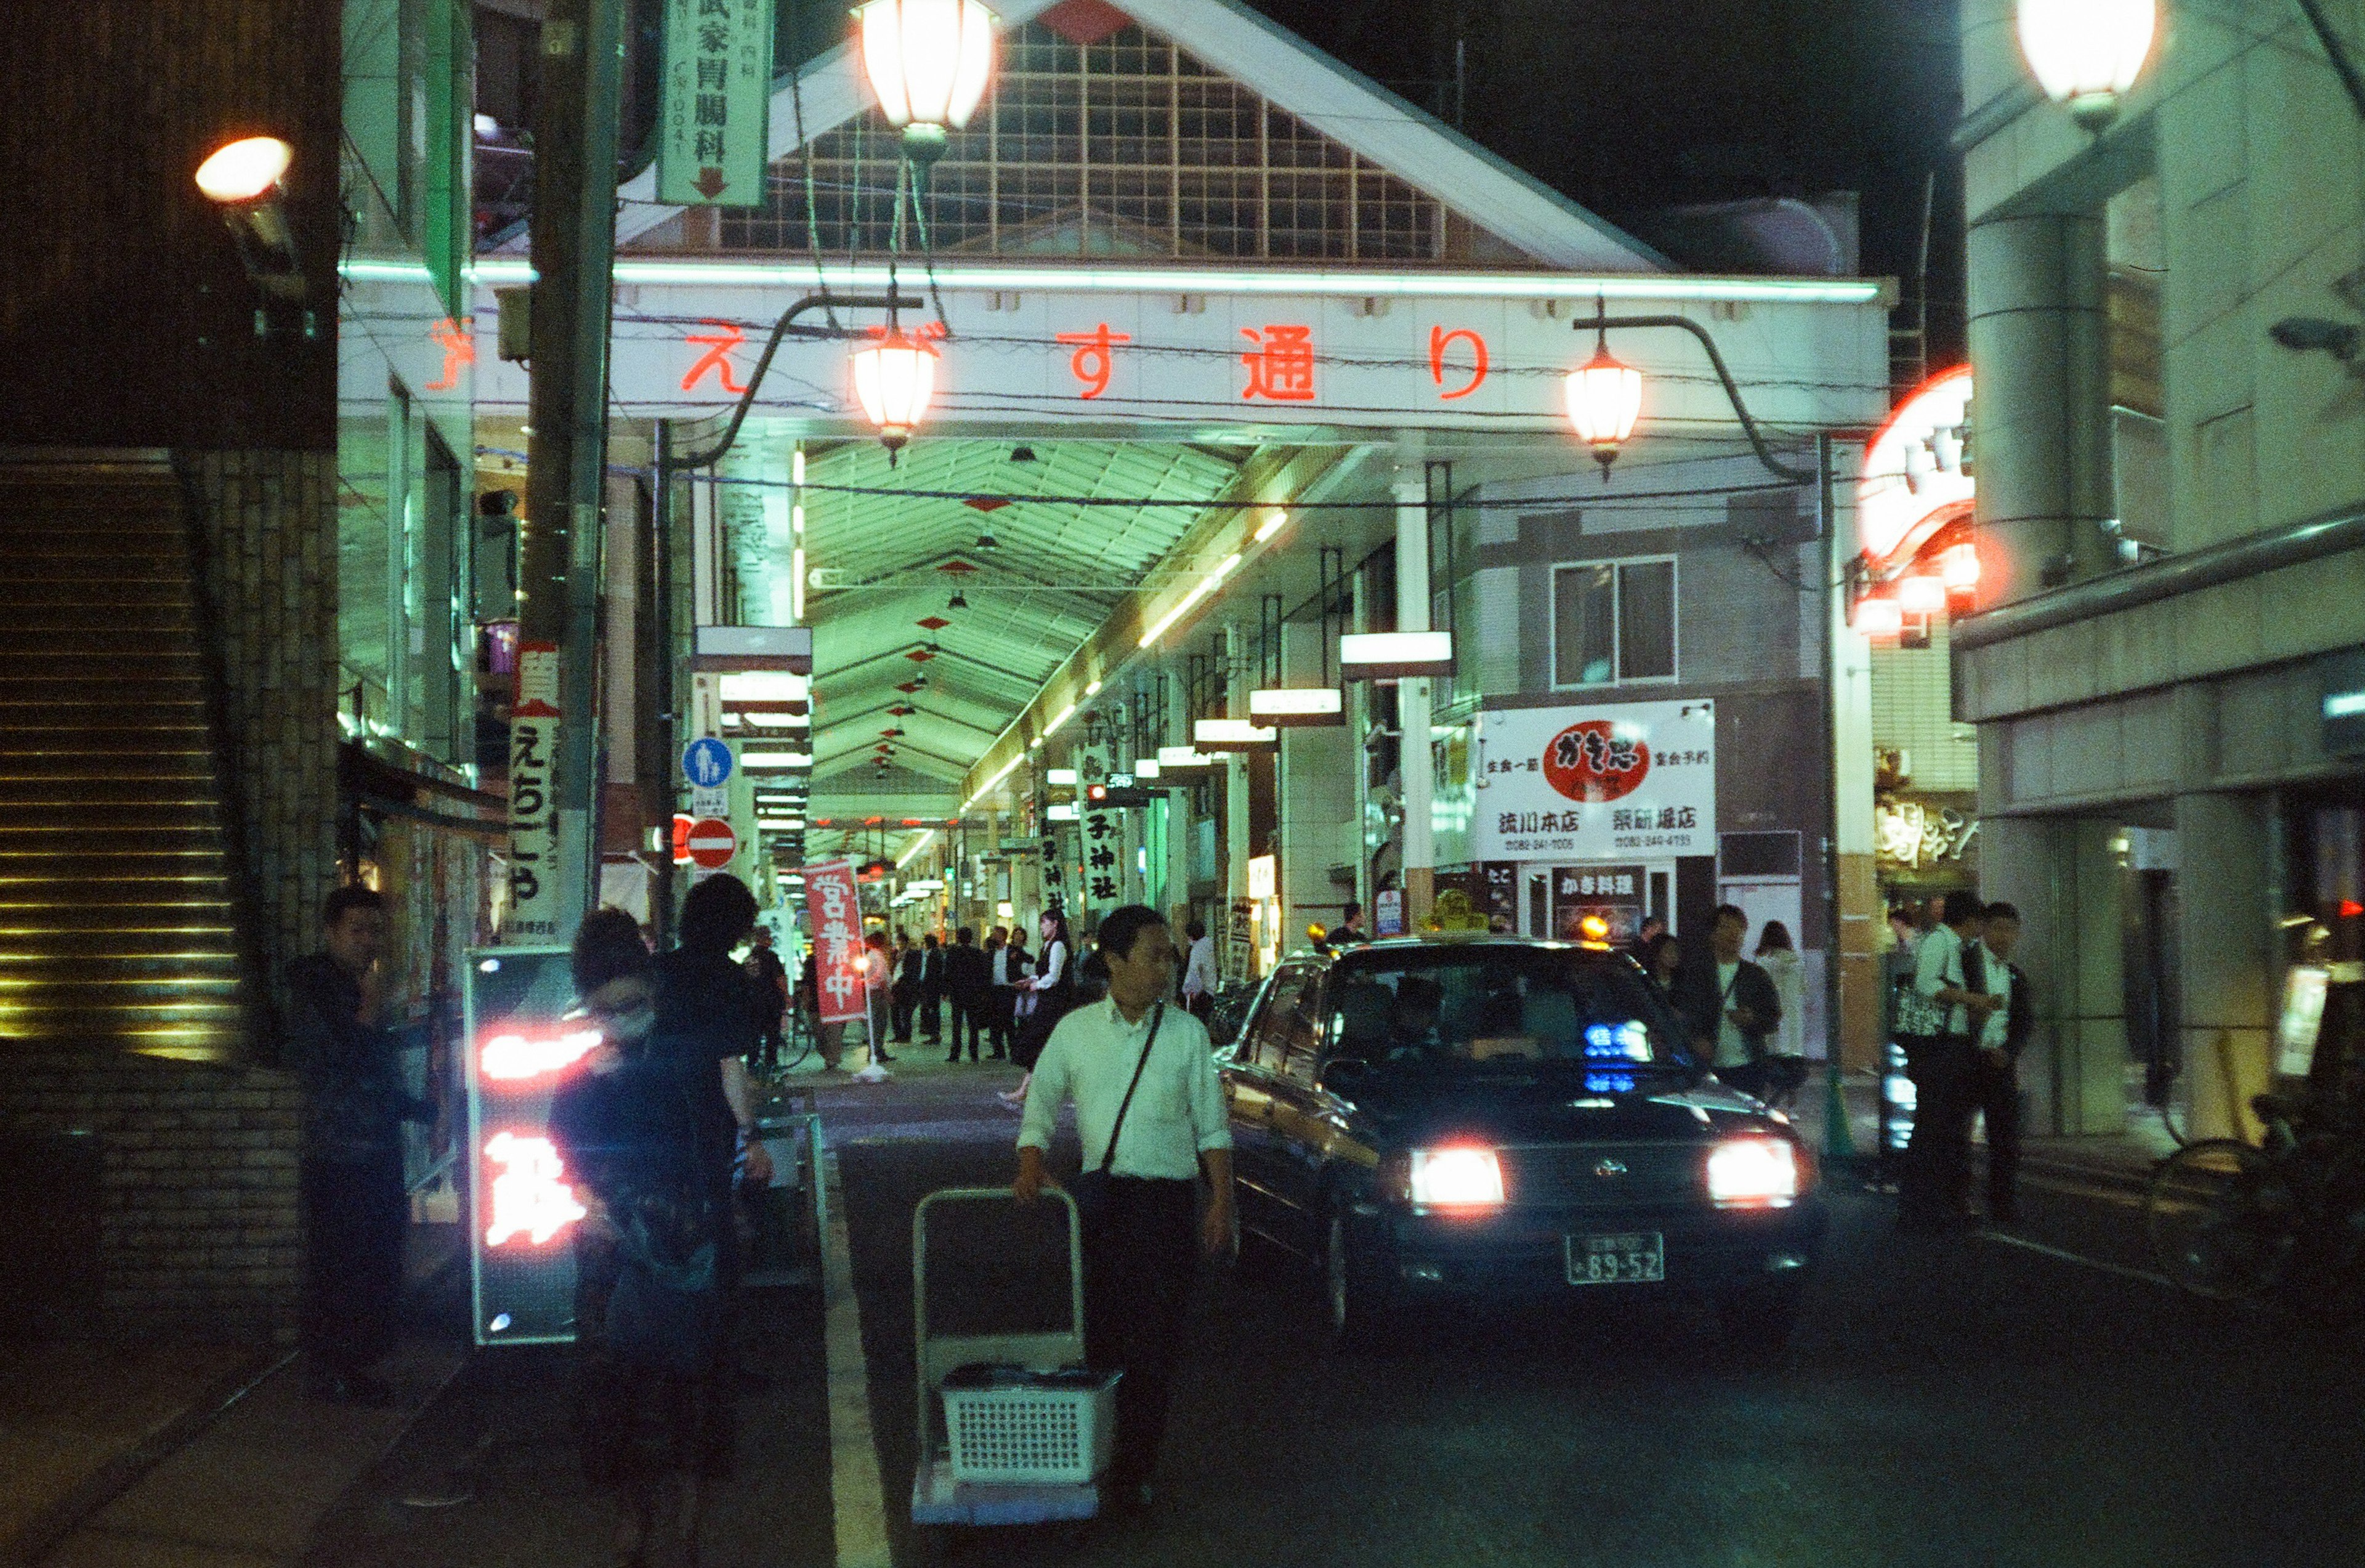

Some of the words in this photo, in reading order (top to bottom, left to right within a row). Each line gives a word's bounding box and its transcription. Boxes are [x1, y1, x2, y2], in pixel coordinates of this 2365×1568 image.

[1499, 810, 1579, 834] 流川本店
[1613, 806, 1696, 831] 薬研堀店
[1084, 785, 1117, 900] 子神社
[1561, 873, 1634, 895] かき料理
[812, 873, 855, 1010] 営業中
